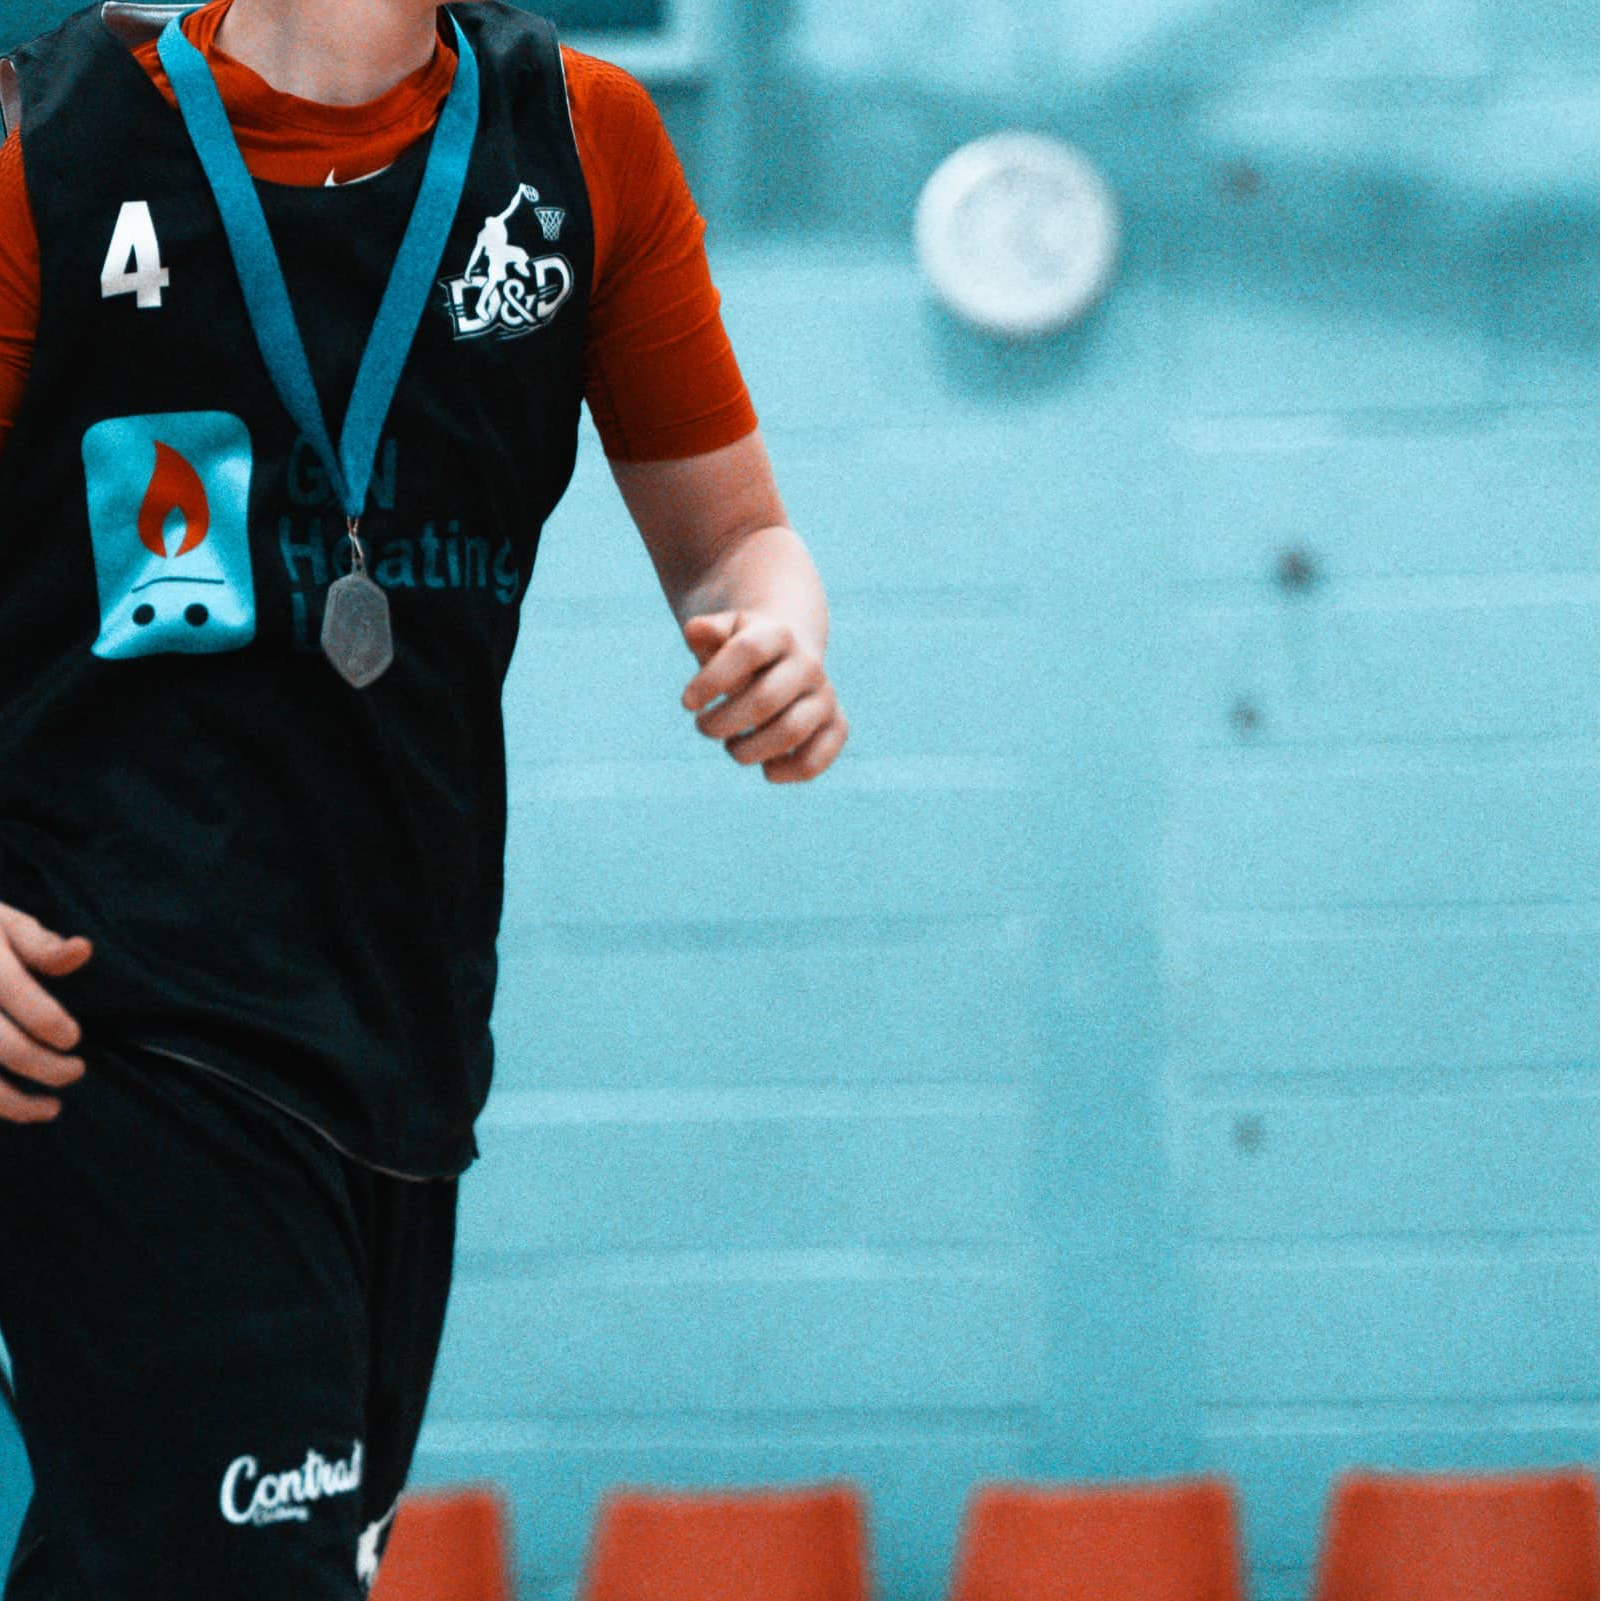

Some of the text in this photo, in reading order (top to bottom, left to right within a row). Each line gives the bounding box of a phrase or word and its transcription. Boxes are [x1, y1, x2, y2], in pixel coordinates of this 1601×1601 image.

[100, 201, 170, 309] 4
[449, 255, 573, 334] D&D
[277, 516, 521, 605] Heating
